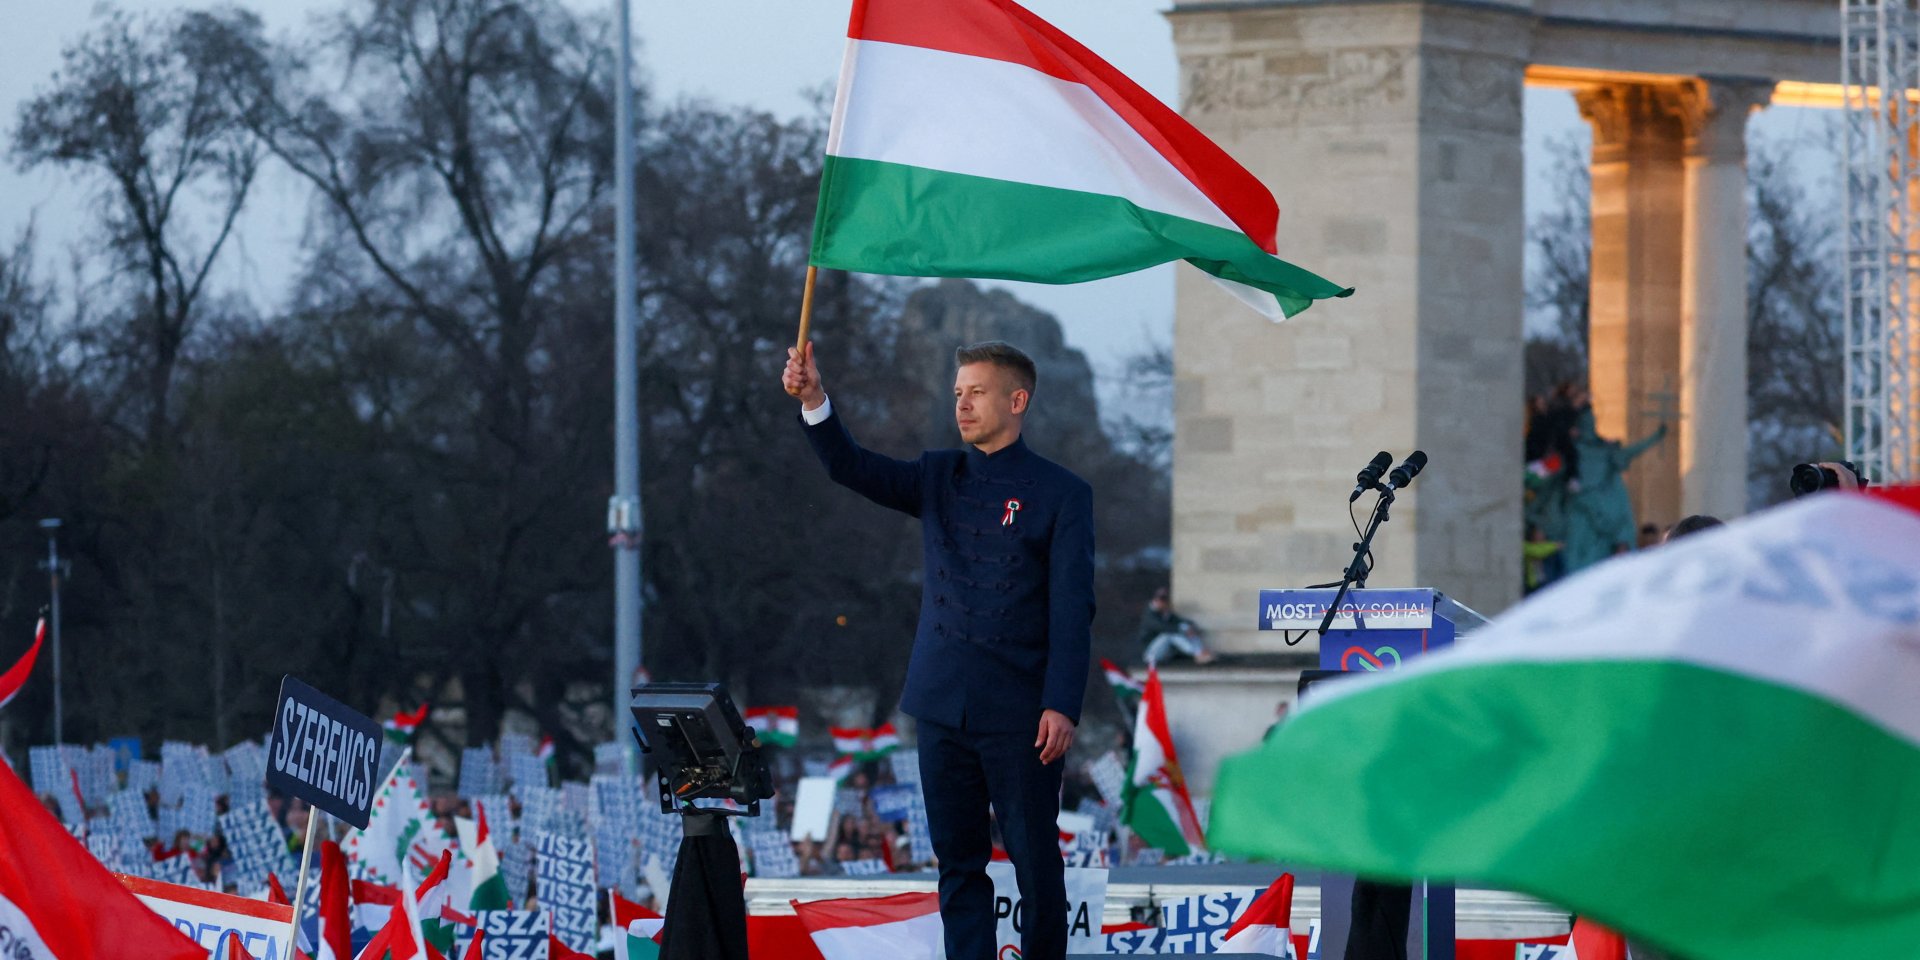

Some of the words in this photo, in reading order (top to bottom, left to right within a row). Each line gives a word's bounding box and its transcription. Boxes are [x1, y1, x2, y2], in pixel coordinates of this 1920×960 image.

[1266, 604, 1316, 619] MOST
[1321, 603, 1365, 618] VAGY
[1371, 603, 1425, 618] SOHA!
[275, 696, 376, 811] SZERENCS
[536, 830, 594, 862] TISZA
[537, 854, 595, 886] TISZA
[538, 878, 597, 910] TISZA
[1161, 889, 1255, 931] TISZ
[453, 938, 549, 960] TSZA
[1168, 929, 1229, 954] TIS
